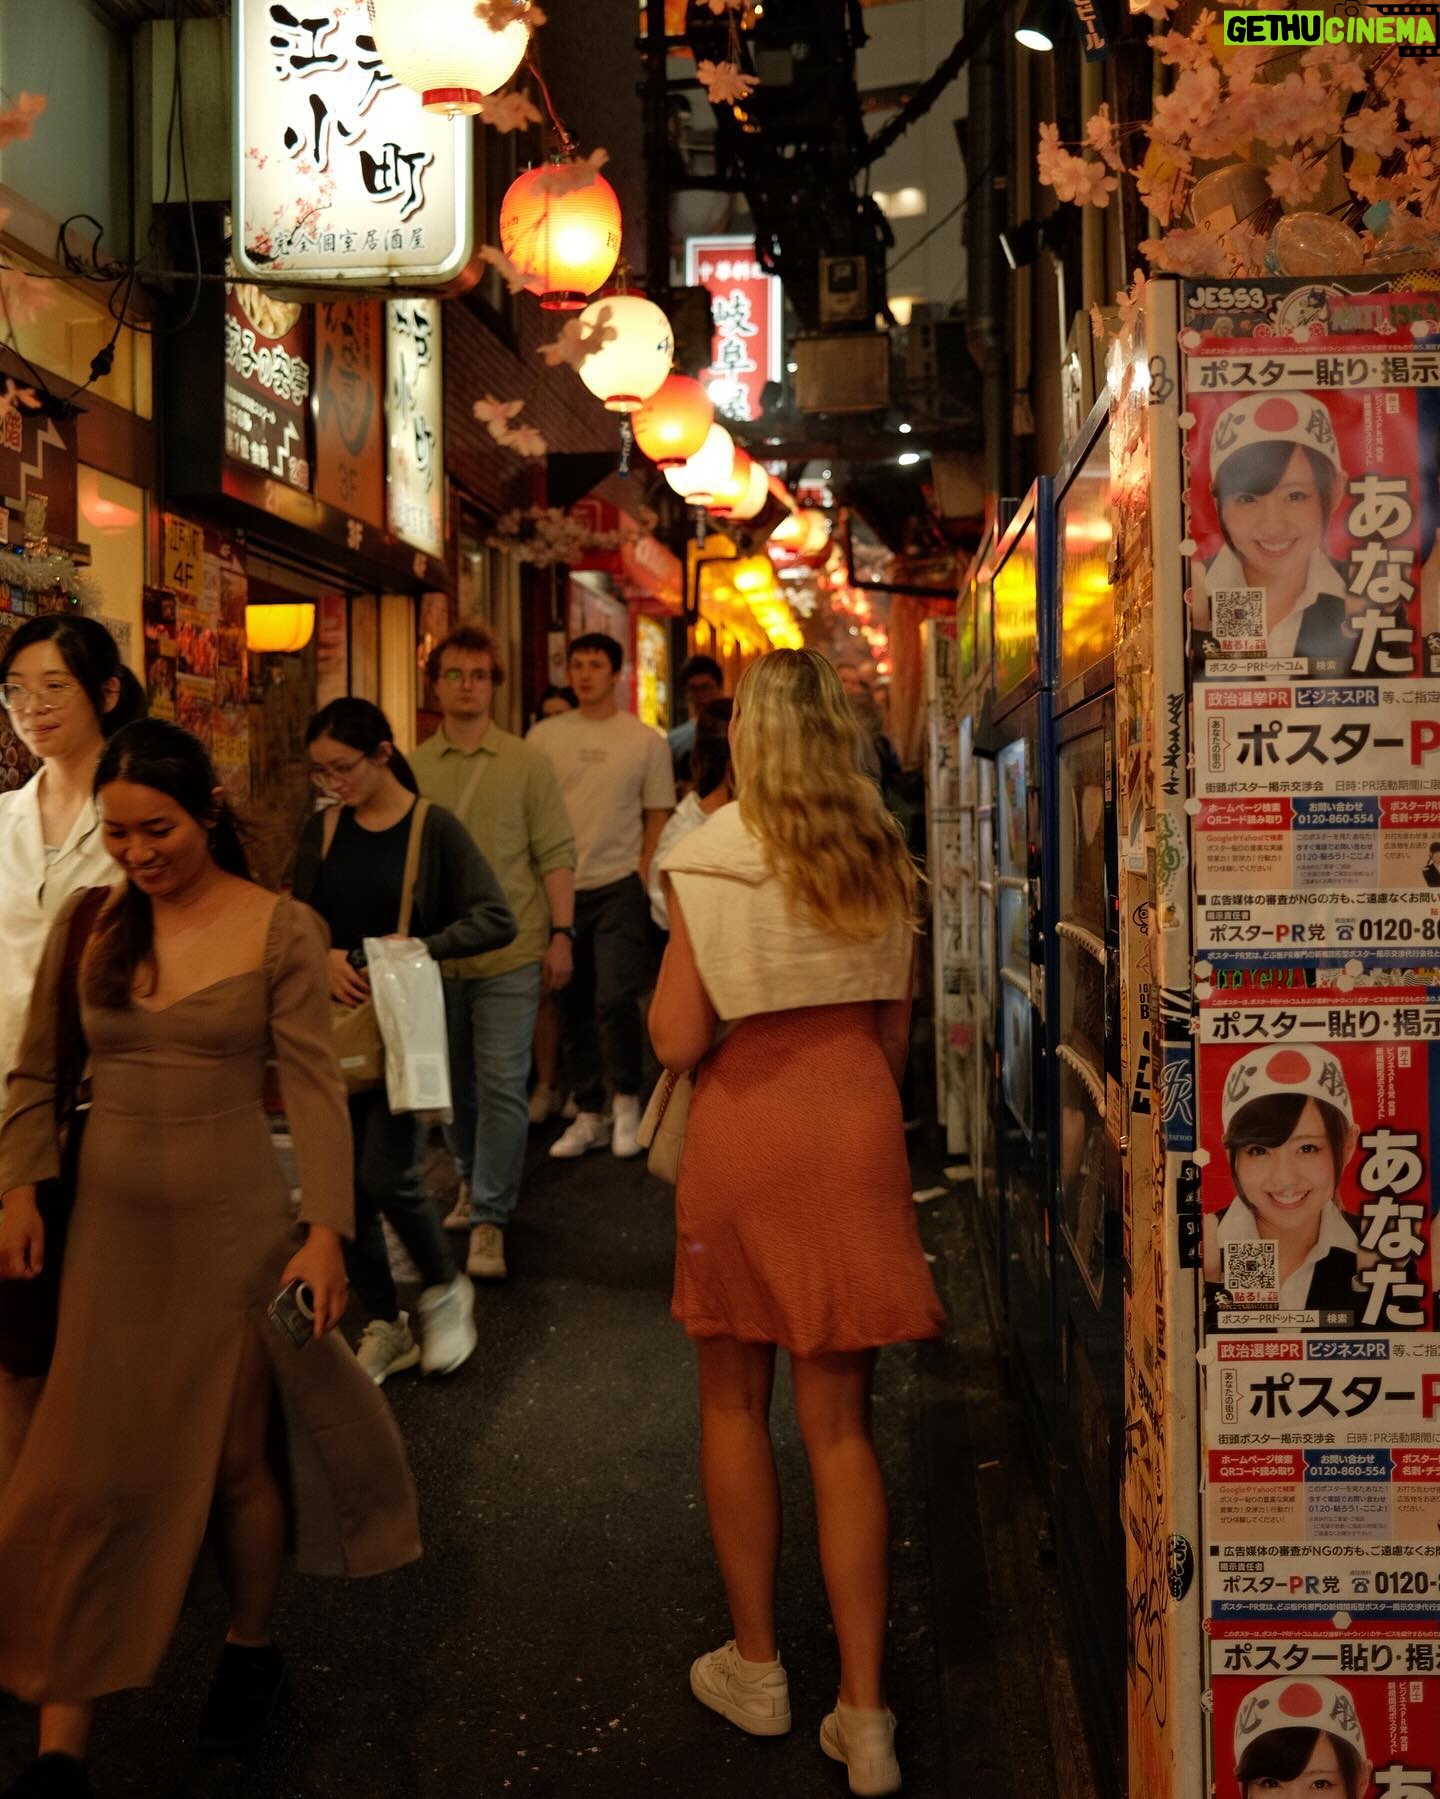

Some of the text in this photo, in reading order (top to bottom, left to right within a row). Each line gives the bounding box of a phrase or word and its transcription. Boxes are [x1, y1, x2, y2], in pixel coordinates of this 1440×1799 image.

[1188, 286, 1266, 310] JESS3
[172, 560, 195, 590] 4F
[1348, 475, 1416, 673] あなた
[1207, 690, 1289, 707] 政治選挙PR
[1297, 689, 1377, 706] ビジネスPR
[1308, 802, 1364, 812] お問い合わせ
[1390, 800, 1440, 811] ポスターPR
[1298, 813, 1374, 825] 0120-860-554
[1209, 923, 1326, 943] ポスターPR党
[1360, 1129, 1425, 1326] あなた
[1222, 1313, 1315, 1325] ポスターPRドットコム
[1219, 1343, 1300, 1359] 政治選挙PR
[1308, 1342, 1388, 1358] ビジネスPR
[1218, 1432, 1336, 1446] 街頭ポスター掲示交渉会
[1221, 1455, 1294, 1465] ホームページ検索
[1320, 1454, 1376, 1465] お問い合わせ
[1402, 1454, 1440, 1465] ポスター
[1219, 1466, 1296, 1477] QRコード読み取り
[1310, 1466, 1387, 1477] 0120-860-554
[1223, 1570, 1440, 1595] ポスターPR党 0120-
[1224, 1643, 1440, 1672] ポスター貼り・掲
